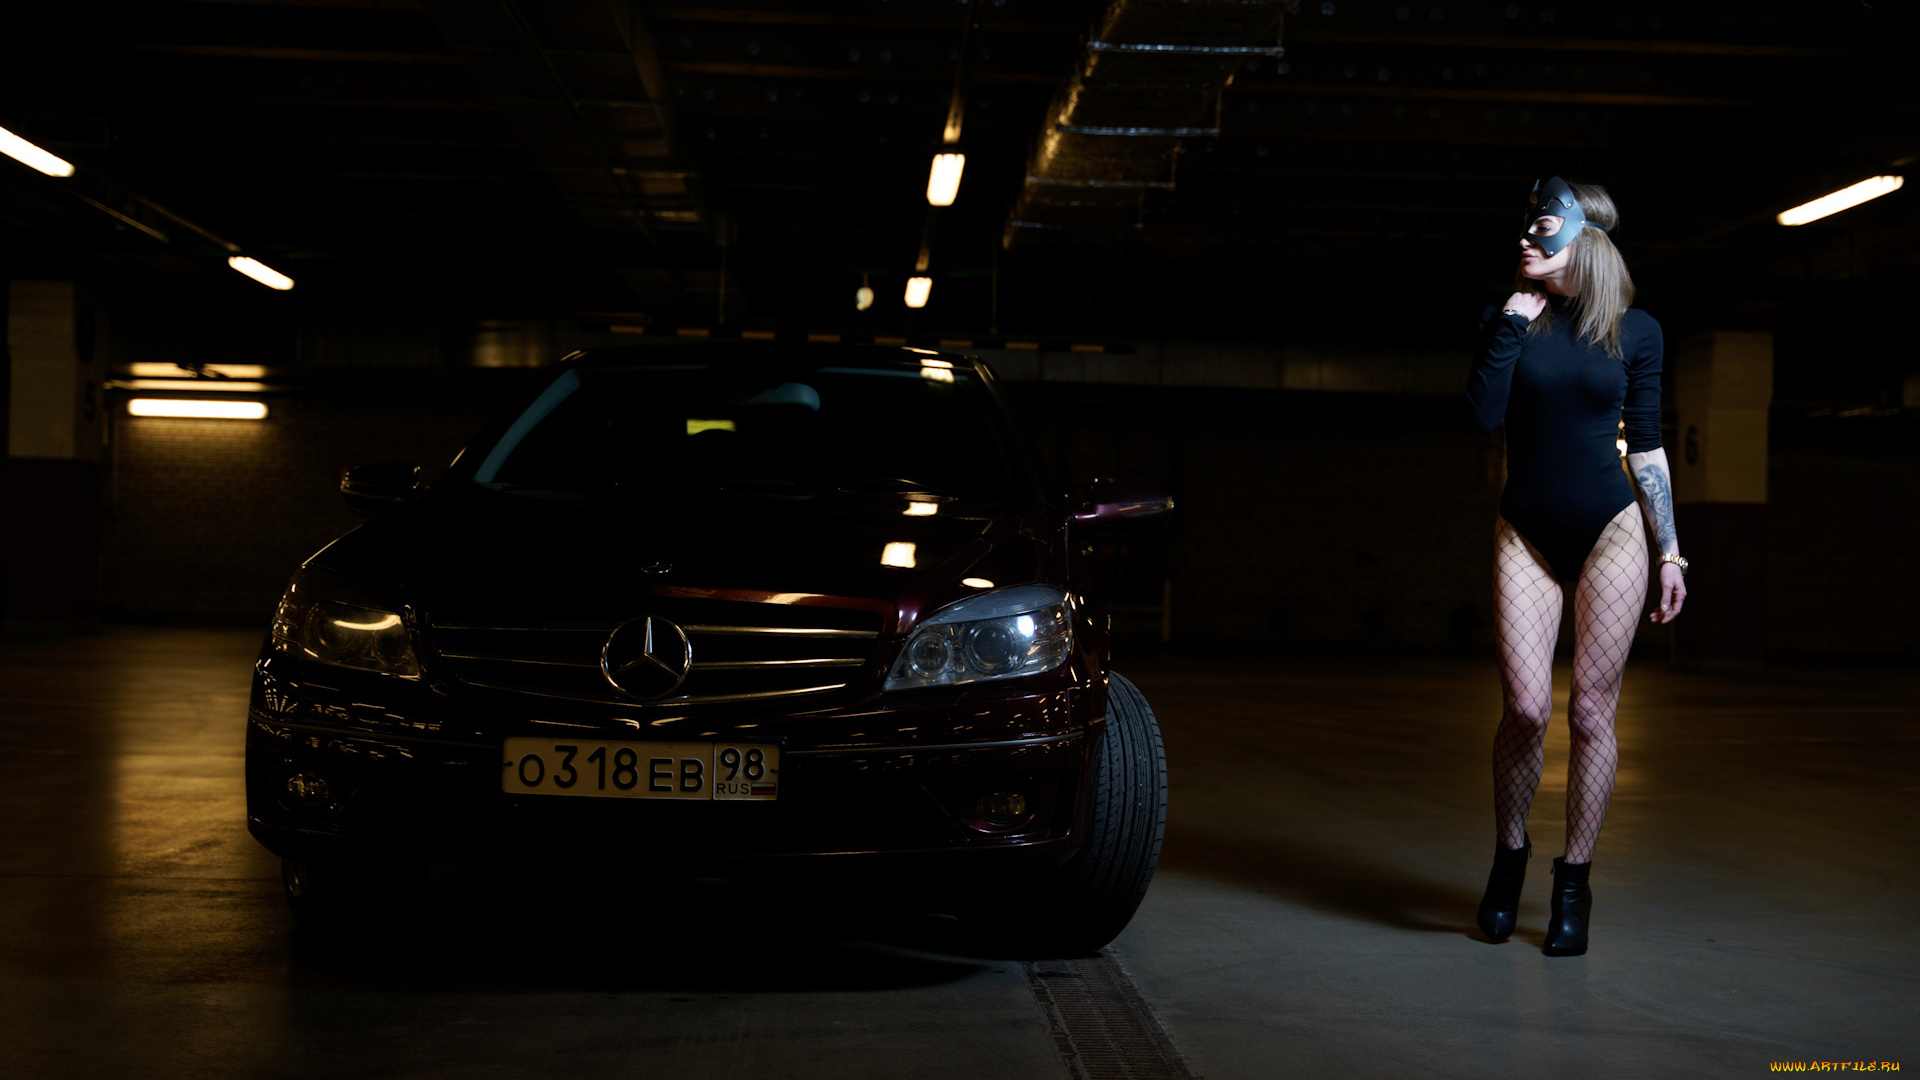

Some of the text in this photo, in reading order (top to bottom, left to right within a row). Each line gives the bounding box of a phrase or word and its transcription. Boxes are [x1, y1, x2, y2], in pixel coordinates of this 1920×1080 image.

[1685, 425, 1698, 466] 6
[720, 748, 765, 781] 98
[716, 782, 750, 795] RUS
